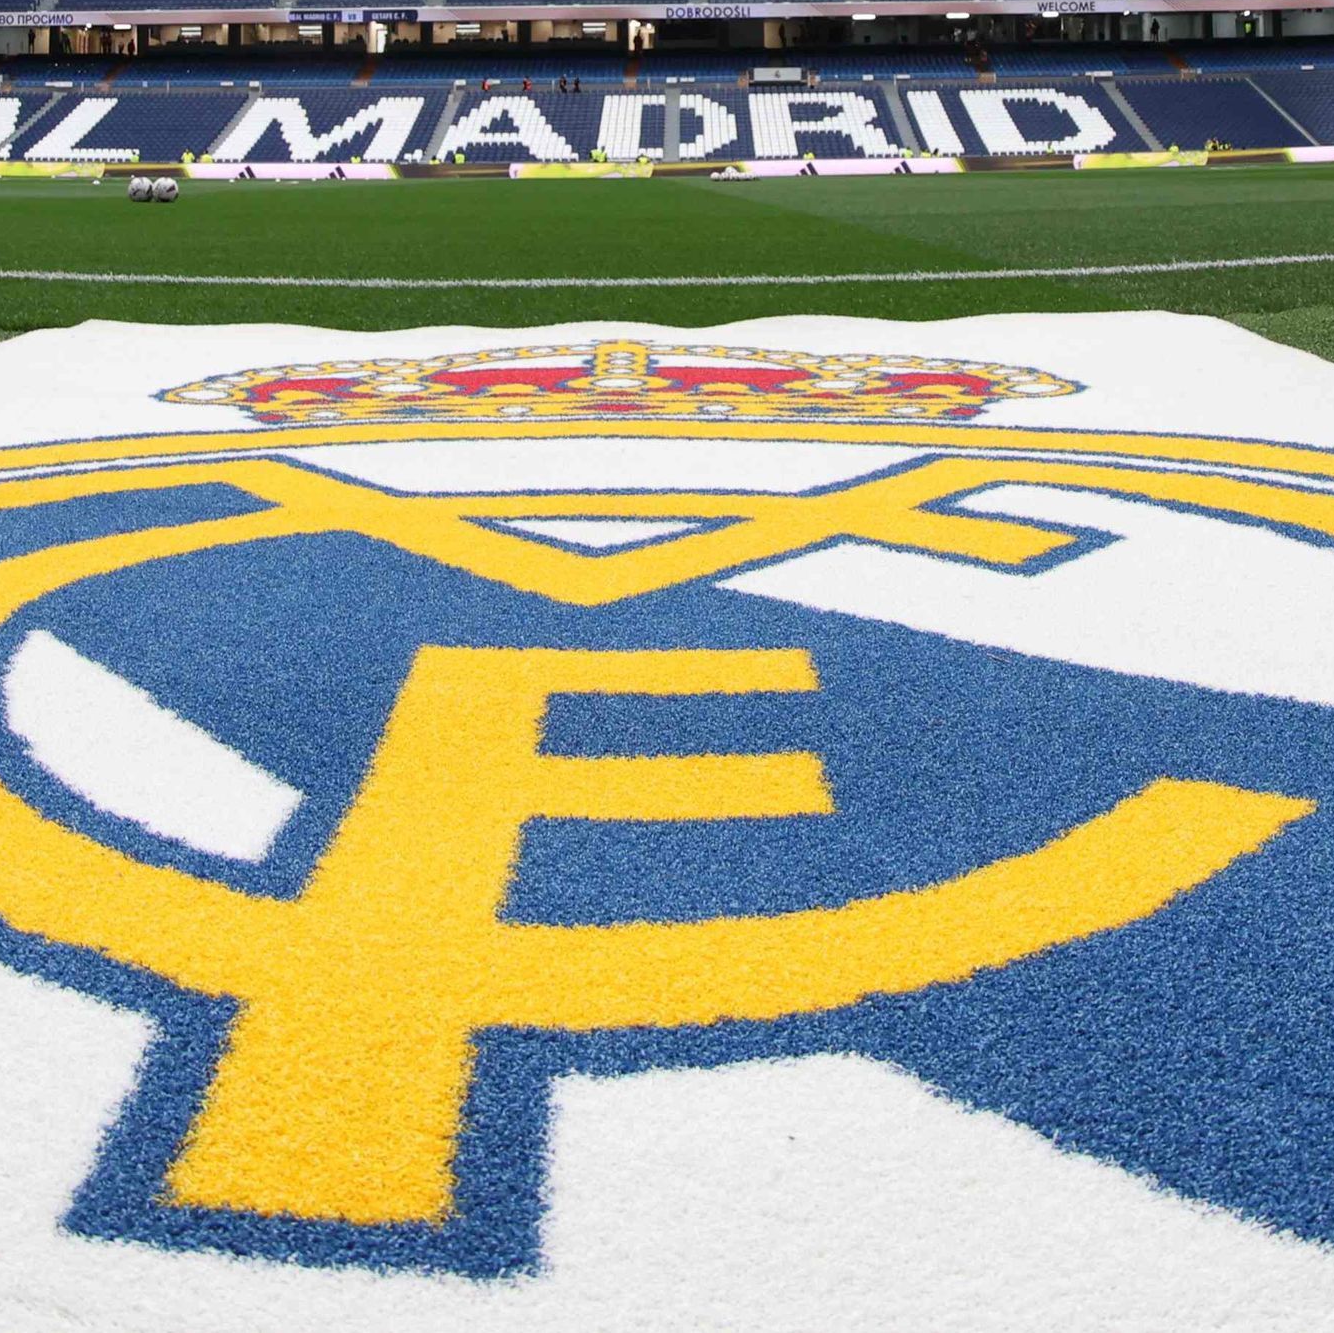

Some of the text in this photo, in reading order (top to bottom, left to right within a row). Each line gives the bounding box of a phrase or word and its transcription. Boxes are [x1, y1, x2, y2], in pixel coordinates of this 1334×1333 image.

[666, 5, 751, 18] DOBRODOŠLI
[1037, 0, 1096, 13] WELCOME
[17, 13, 74, 25] ПРОСИМО
[213, 87, 1119, 164] MADRID
